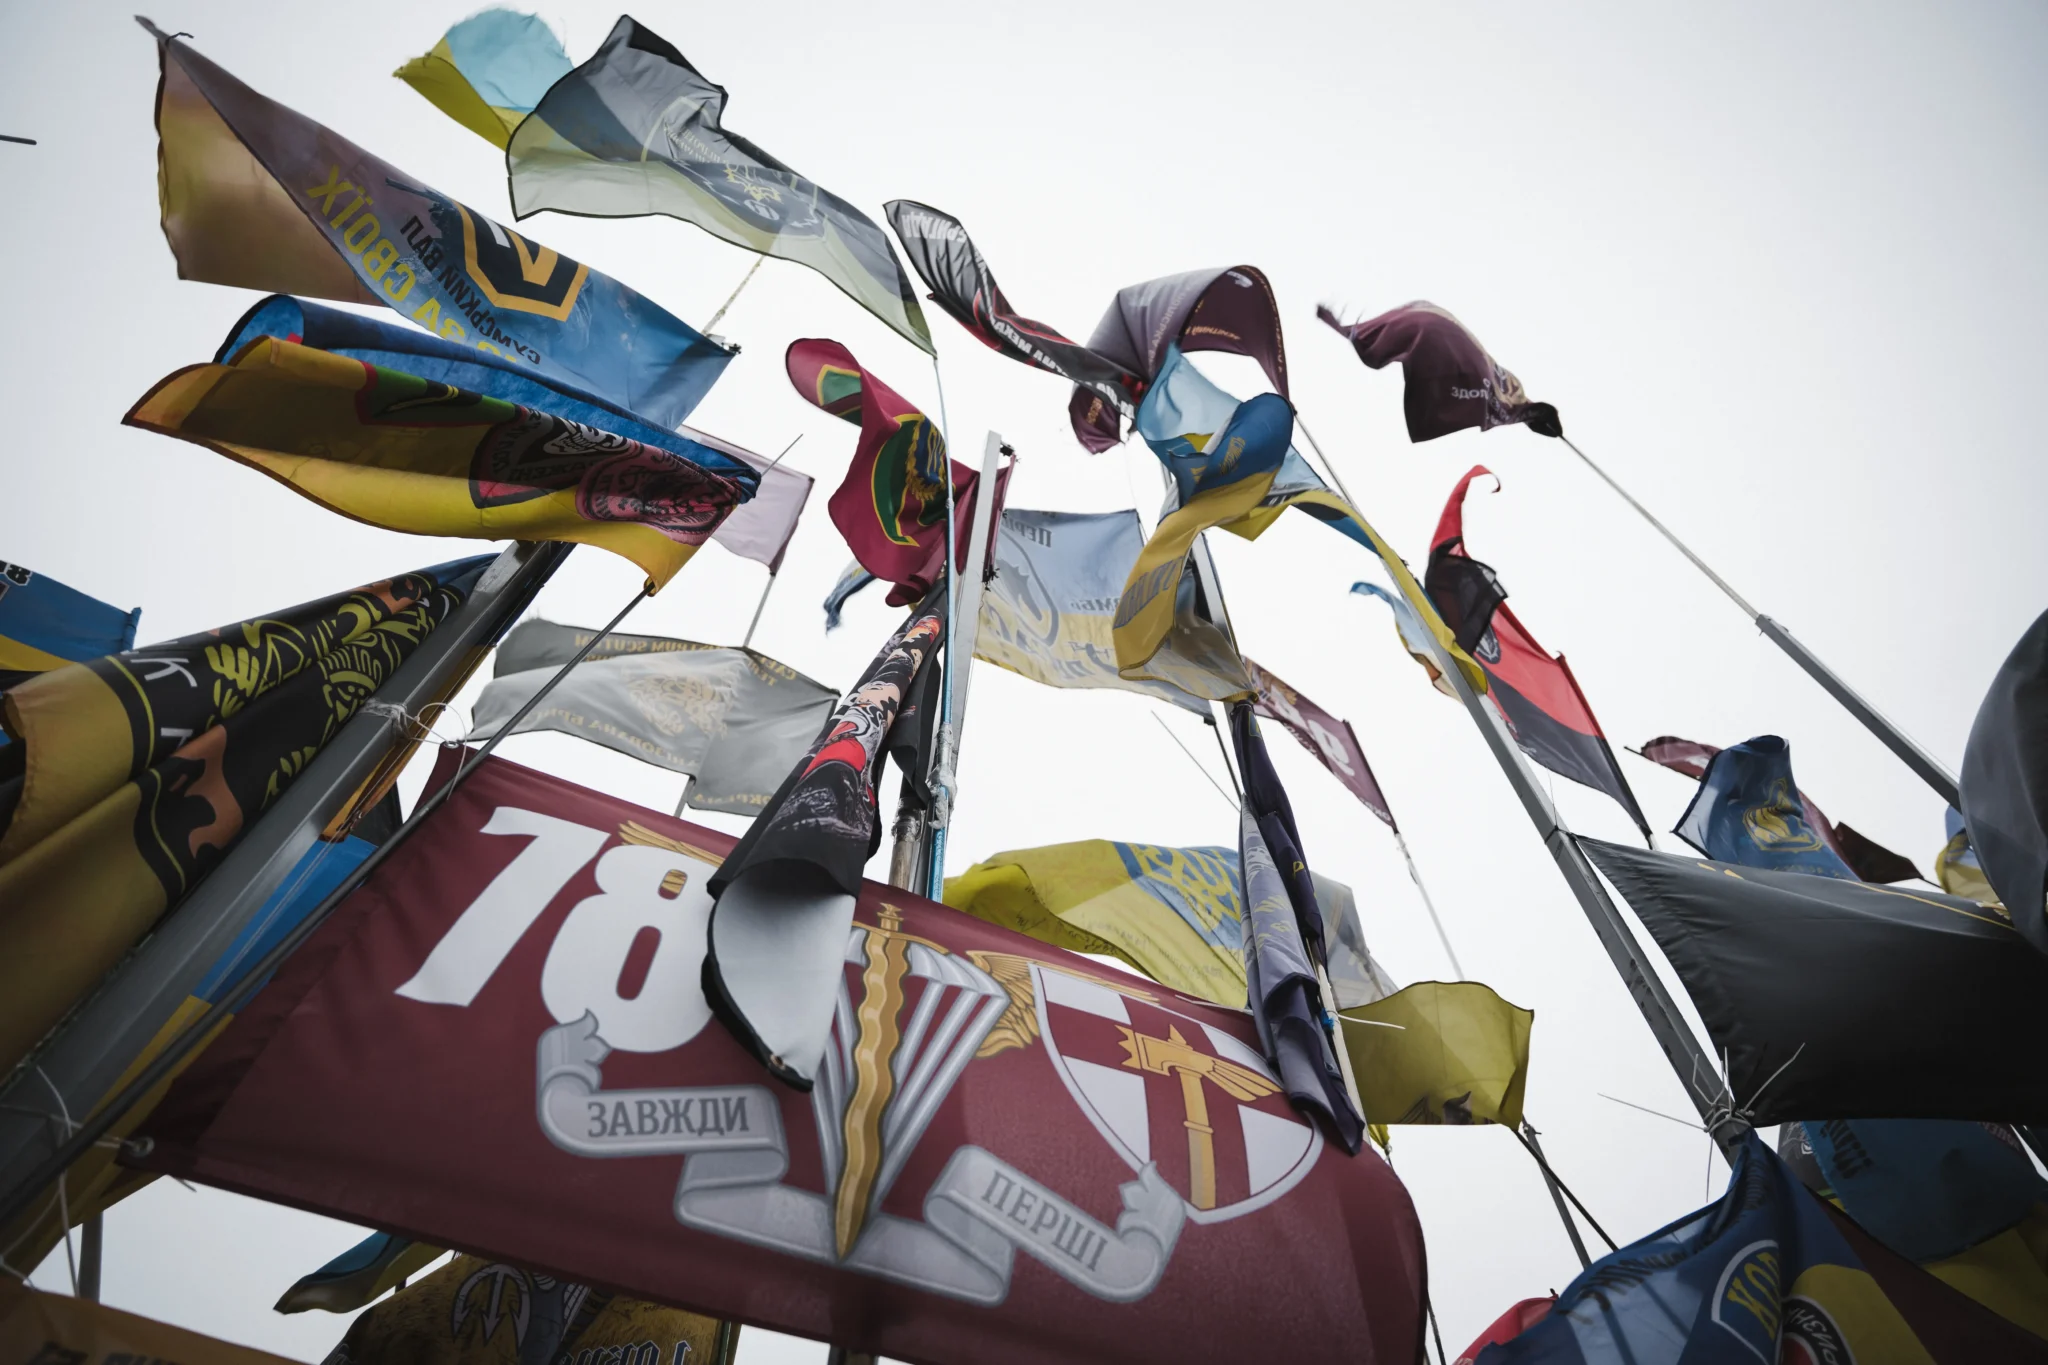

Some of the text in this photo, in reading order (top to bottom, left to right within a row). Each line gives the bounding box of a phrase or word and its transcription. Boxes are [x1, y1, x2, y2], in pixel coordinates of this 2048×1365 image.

[394, 805, 716, 1054] 78
[588, 1091, 748, 1139] ЗАВЖДИ
[980, 1170, 1108, 1272] ПЕРШІ
